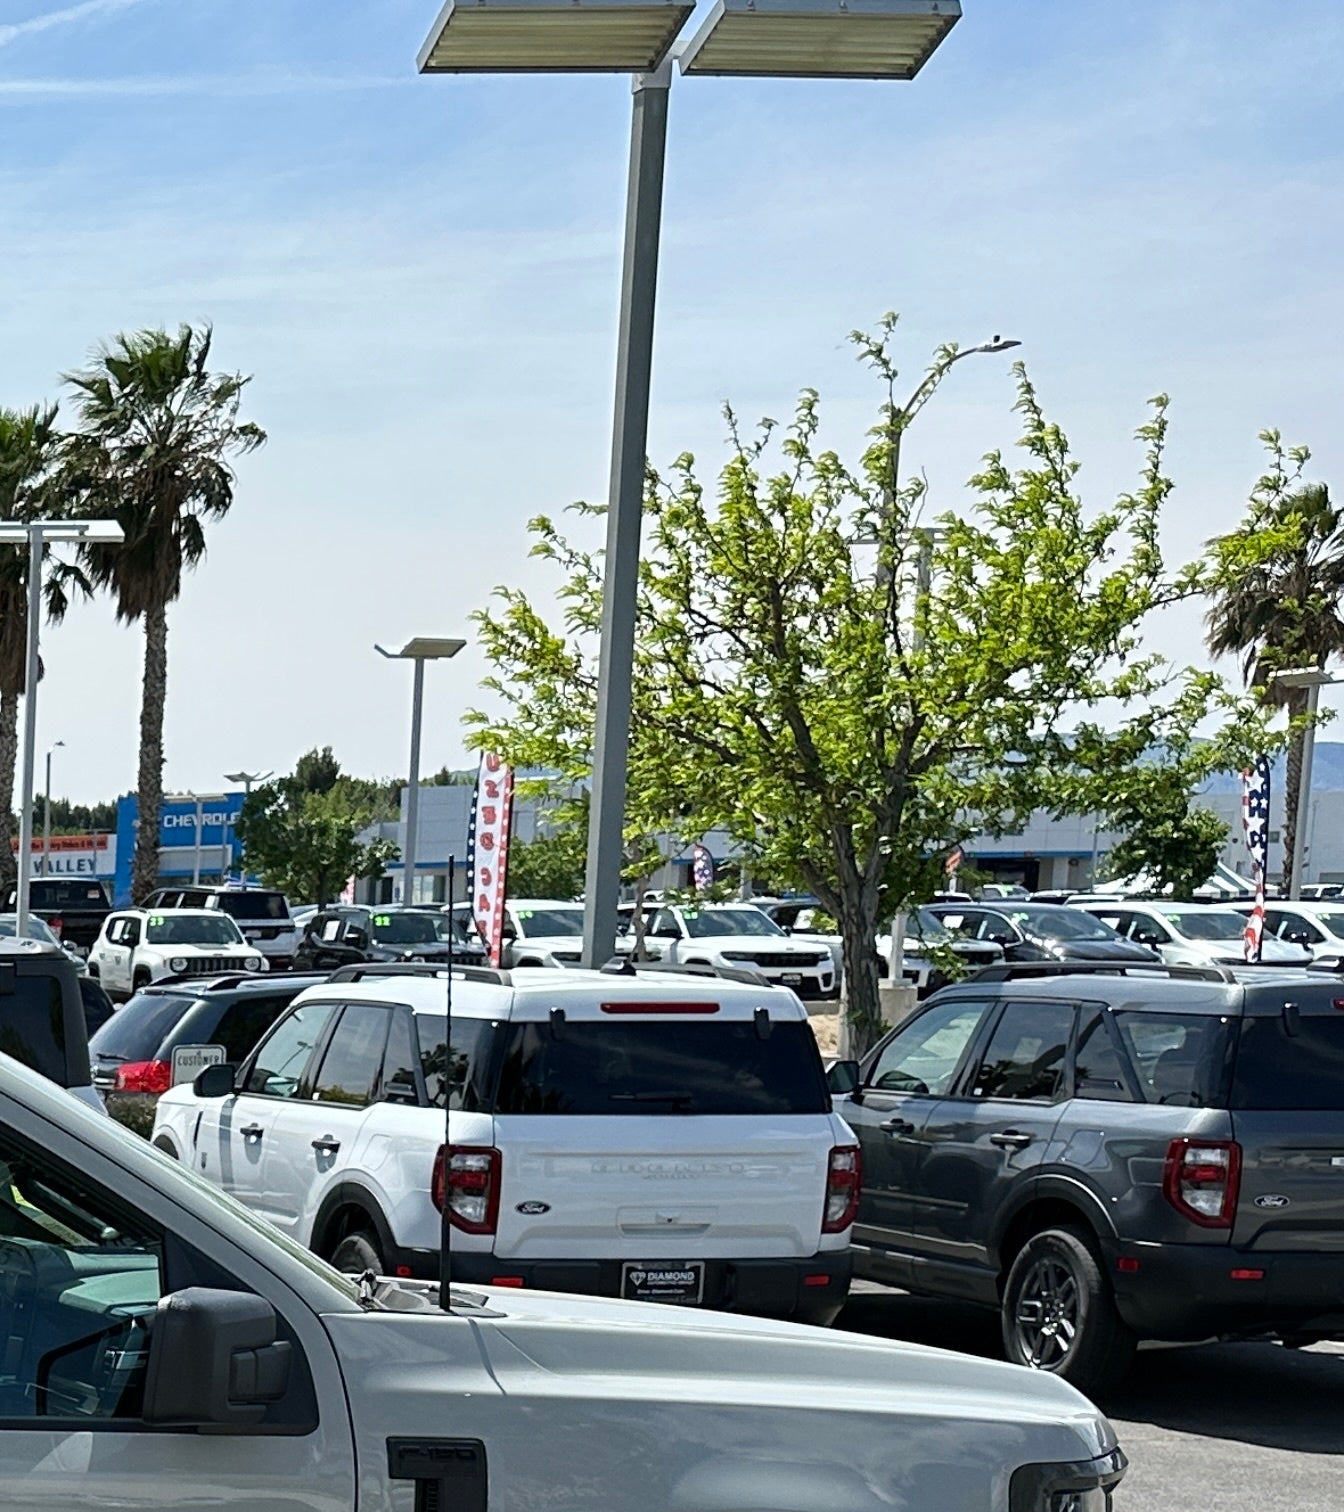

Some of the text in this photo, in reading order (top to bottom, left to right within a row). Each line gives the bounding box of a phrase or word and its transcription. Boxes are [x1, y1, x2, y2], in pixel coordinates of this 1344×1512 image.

[163, 811, 241, 828] CHEVROLE
[177, 1055, 220, 1066] CUSTOMER
[647, 1271, 695, 1281] DIAMOND
[399, 1447, 476, 1460] F-150
